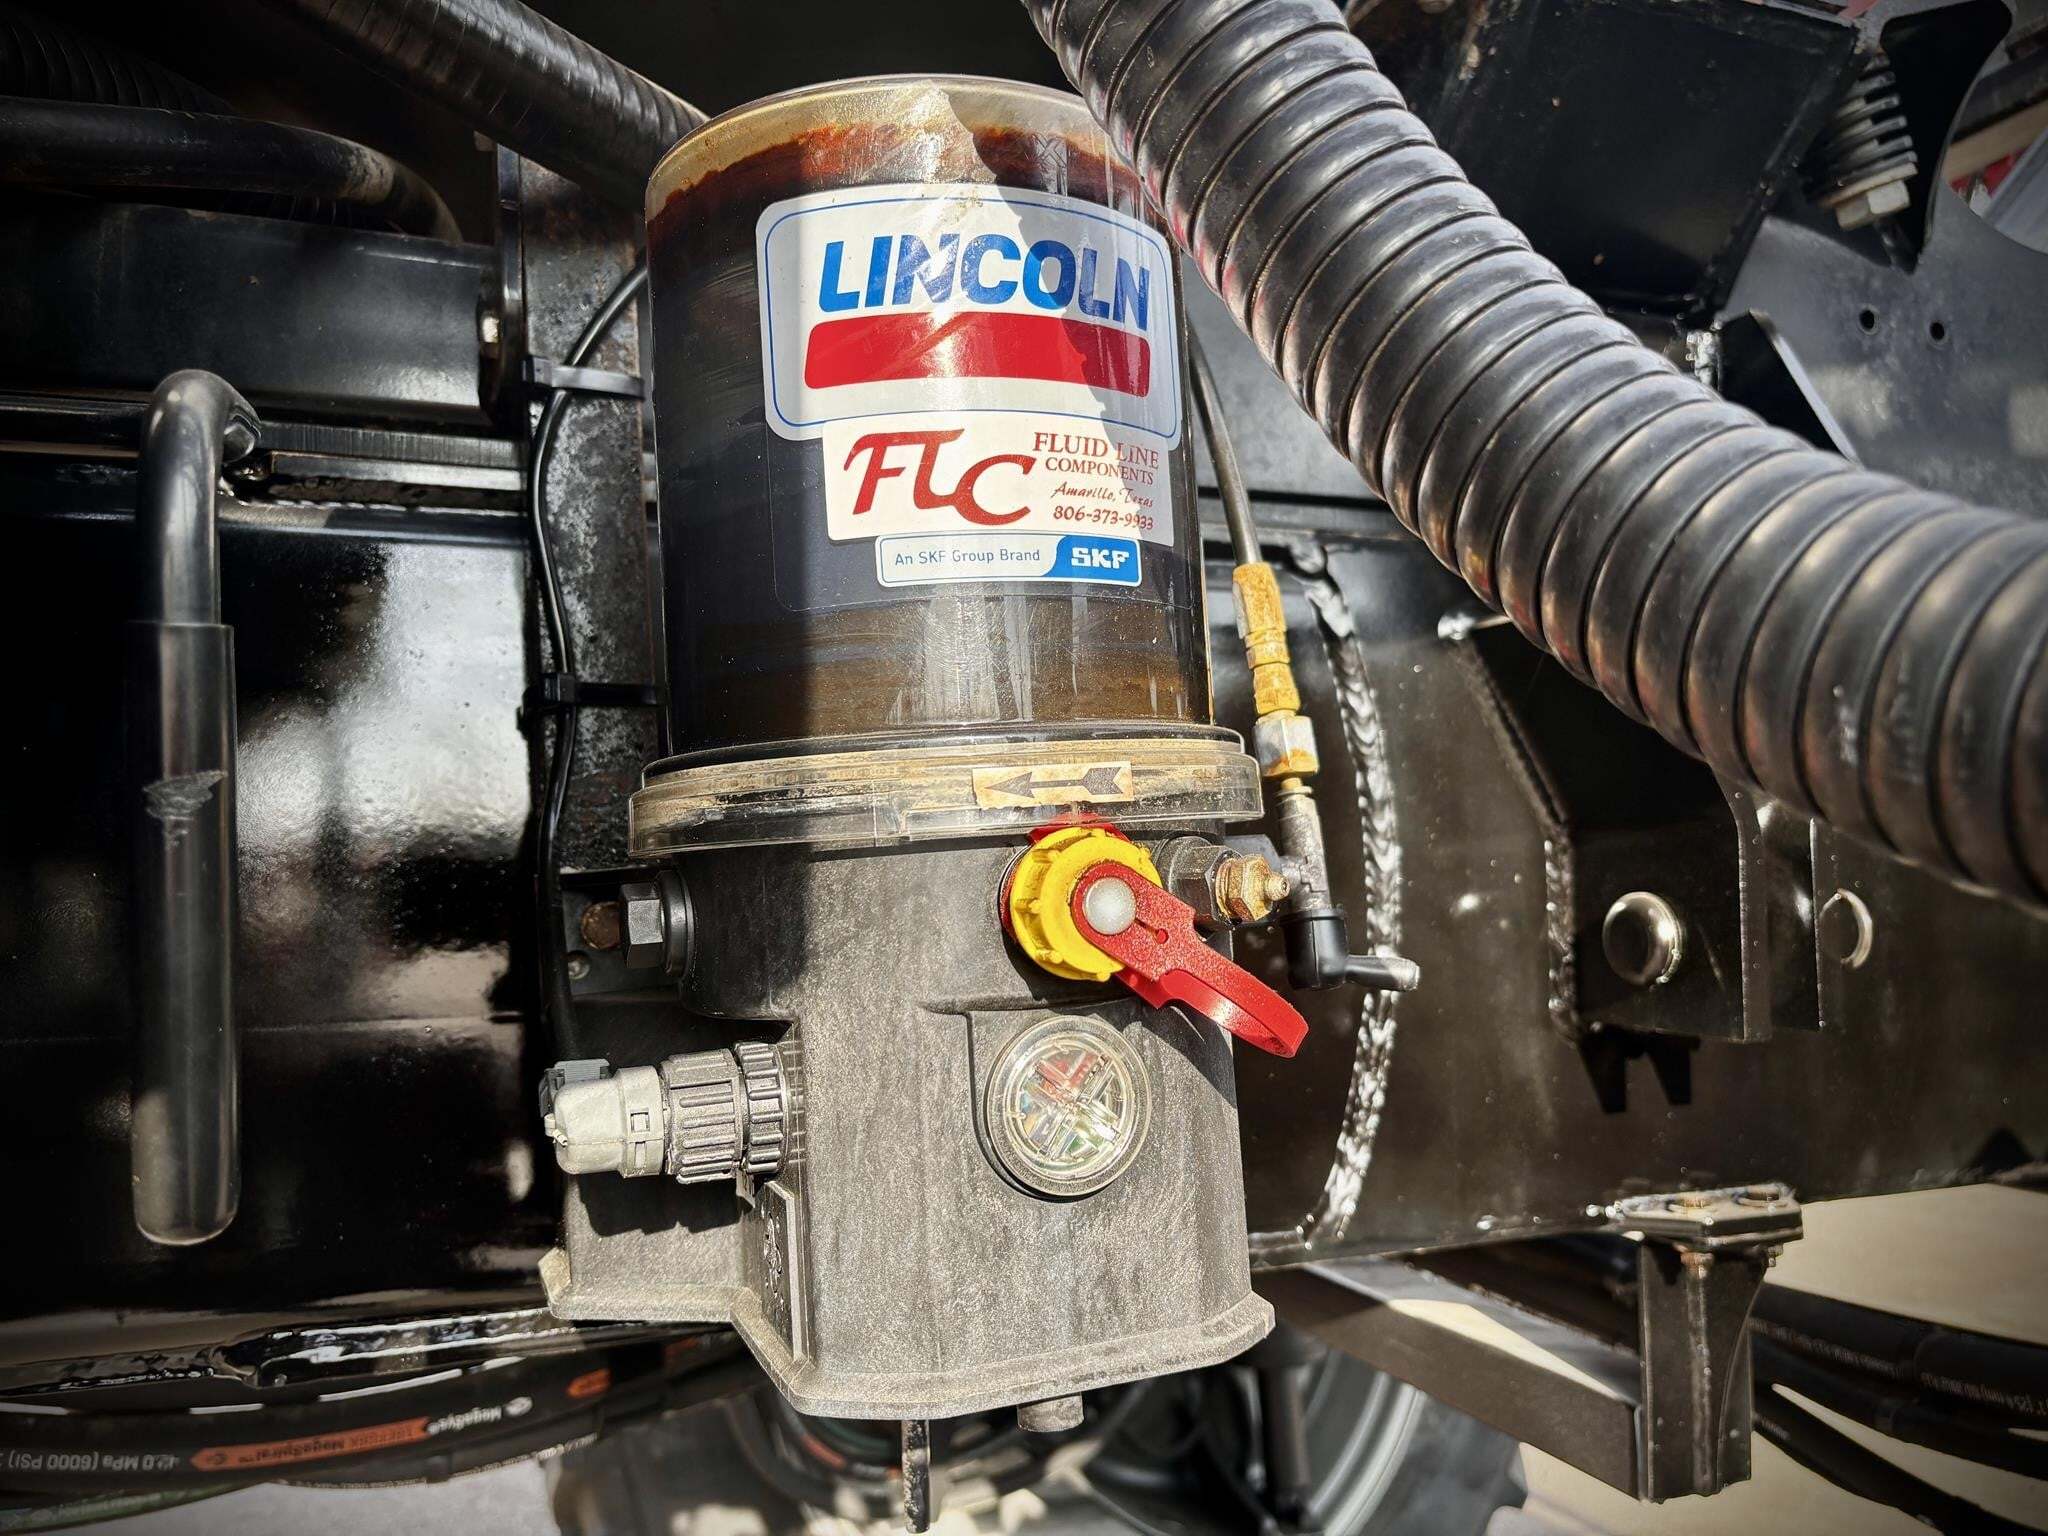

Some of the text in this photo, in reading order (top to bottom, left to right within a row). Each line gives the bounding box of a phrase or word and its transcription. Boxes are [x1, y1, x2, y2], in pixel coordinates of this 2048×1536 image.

[819, 233, 1151, 331] LINCOLN
[1032, 431, 1159, 470] FLUID LINE
[1045, 456, 1154, 486] COMPONENTS
[1118, 487, 1153, 508] Texas
[1053, 505, 1154, 530] 806-373-9933
[895, 548, 1040, 566] An SKF Group Brand
[1071, 546, 1130, 570] SKF
[8, 1449, 44, 1470] PSI)
[47, 1451, 100, 1472] (6000
